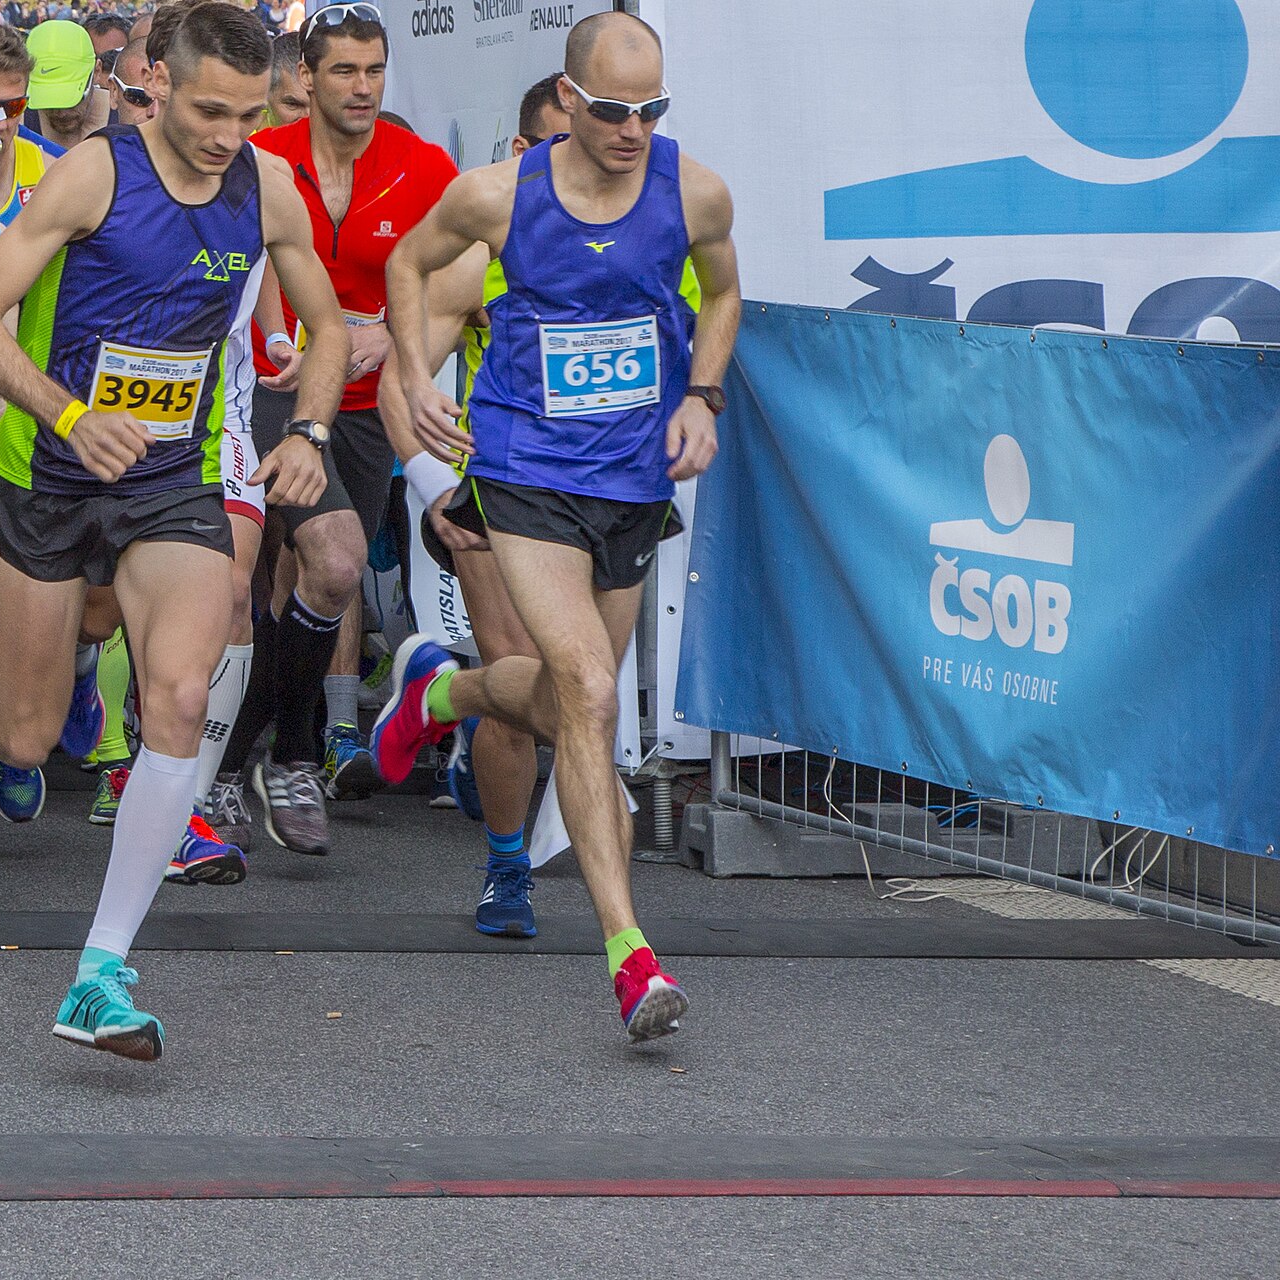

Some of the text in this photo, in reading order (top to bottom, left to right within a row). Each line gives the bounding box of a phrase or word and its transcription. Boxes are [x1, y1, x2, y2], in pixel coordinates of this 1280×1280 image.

[412, 0, 454, 37] adidas
[529, 4, 574, 32] RENAULT
[563, 350, 641, 386] 656
[99, 376, 196, 412] 3945
[929, 552, 1072, 655] ČSOB
[923, 655, 1059, 706] PRE VÁS OSOBNE
